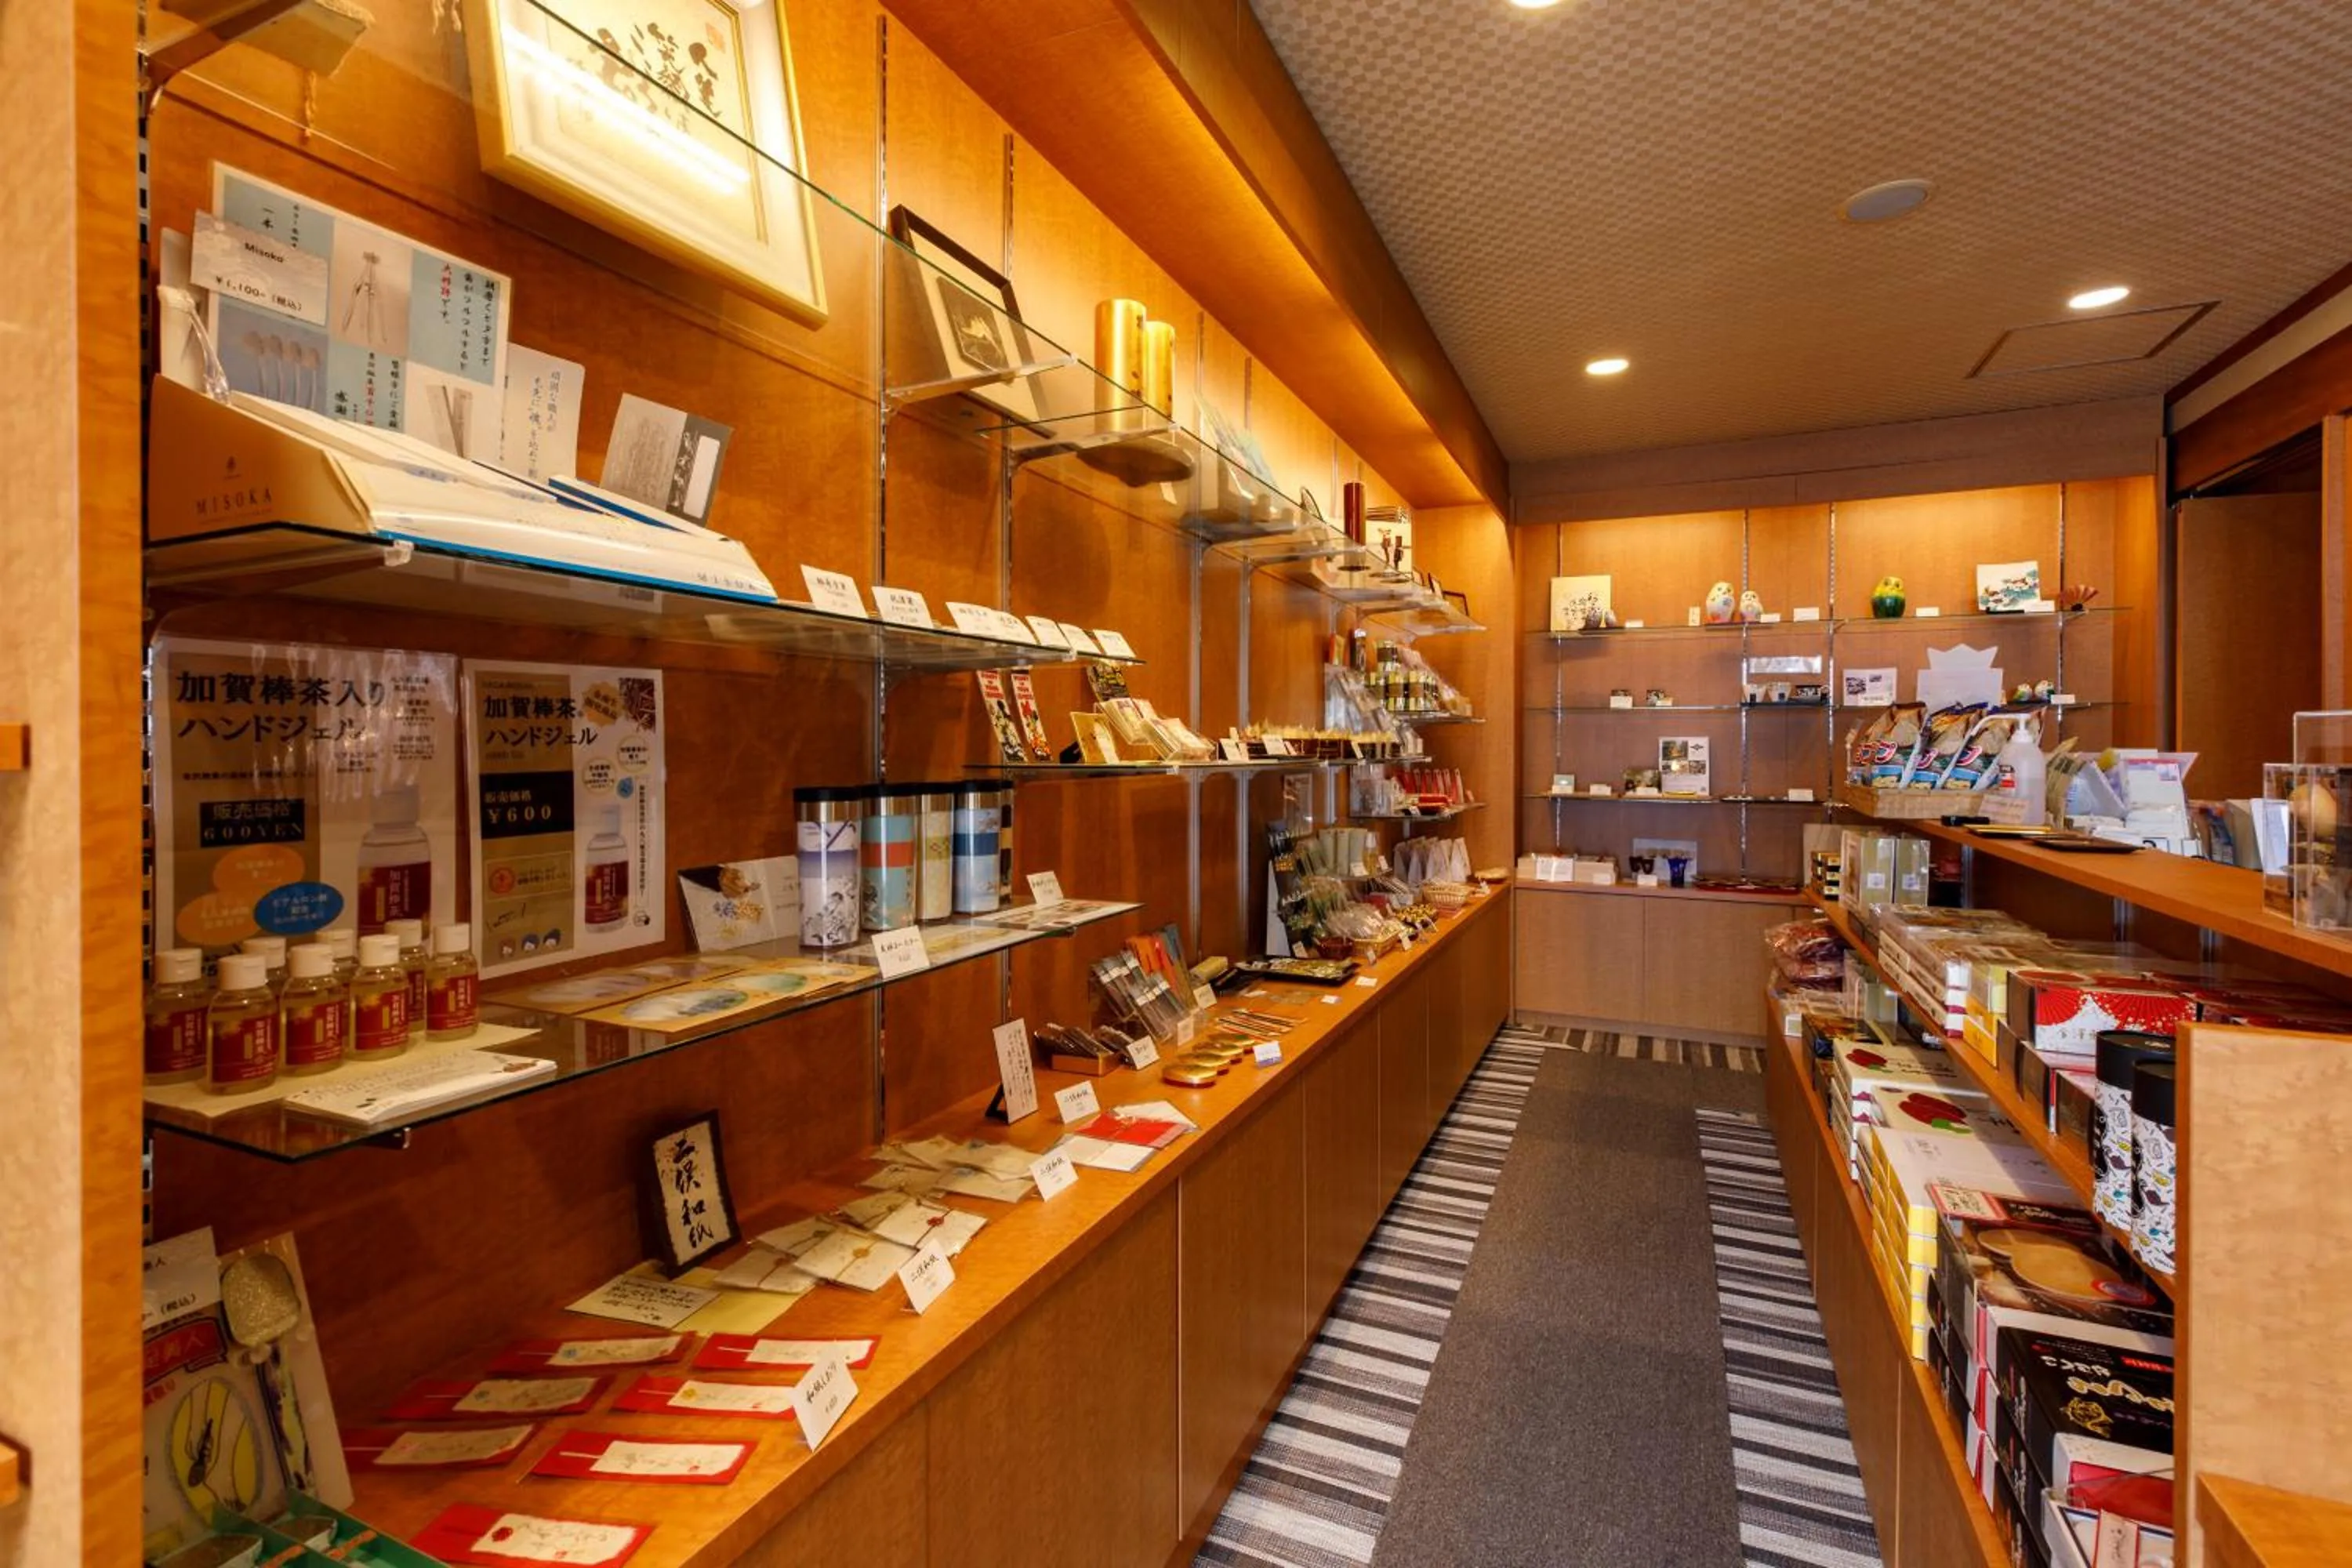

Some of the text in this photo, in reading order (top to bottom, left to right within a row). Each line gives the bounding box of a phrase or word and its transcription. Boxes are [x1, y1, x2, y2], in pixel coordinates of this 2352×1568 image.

[244, 242, 285, 263] Misoka
[196, 488, 272, 515] MISOKA
[176, 670, 385, 706] 加賀棒茶入り
[484, 695, 576, 719] 加賀棒茶
[177, 714, 366, 742] ハンドジェル
[485, 727, 598, 746] ハンドジェル
[485, 790, 532, 803] 販売価格
[212, 800, 291, 821] 販売価格
